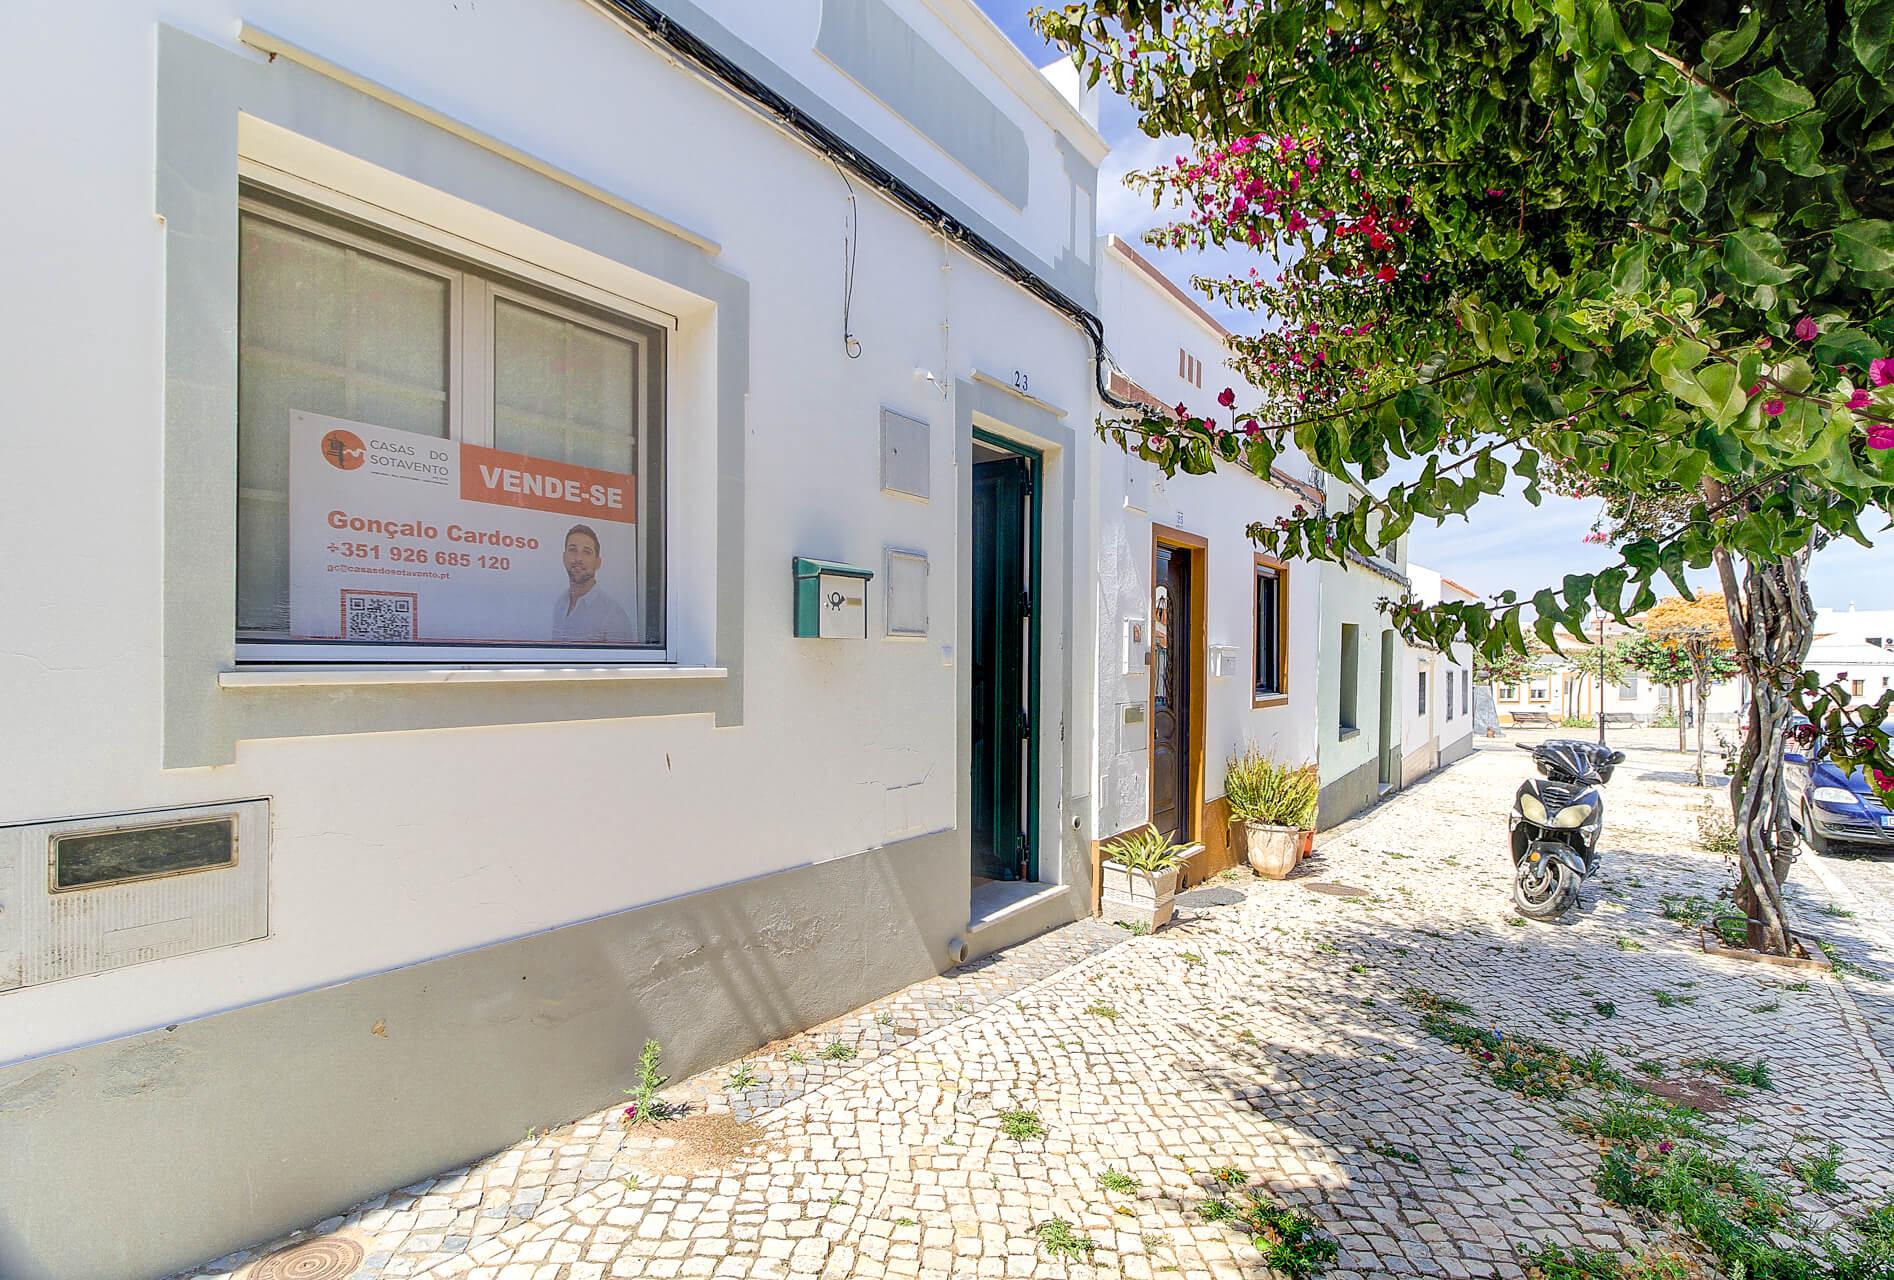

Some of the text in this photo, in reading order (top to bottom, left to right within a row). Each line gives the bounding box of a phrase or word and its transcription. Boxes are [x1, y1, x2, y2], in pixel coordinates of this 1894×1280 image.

[1014, 370, 1028, 391] 23
[370, 440, 448, 462] CASAS DO
[370, 454, 449, 476] SOTAVENTO
[480, 465, 623, 509] VENDE-SE
[327, 510, 539, 550] Gonçalo Cardoso
[327, 542, 510, 571] +351 926 685 120
